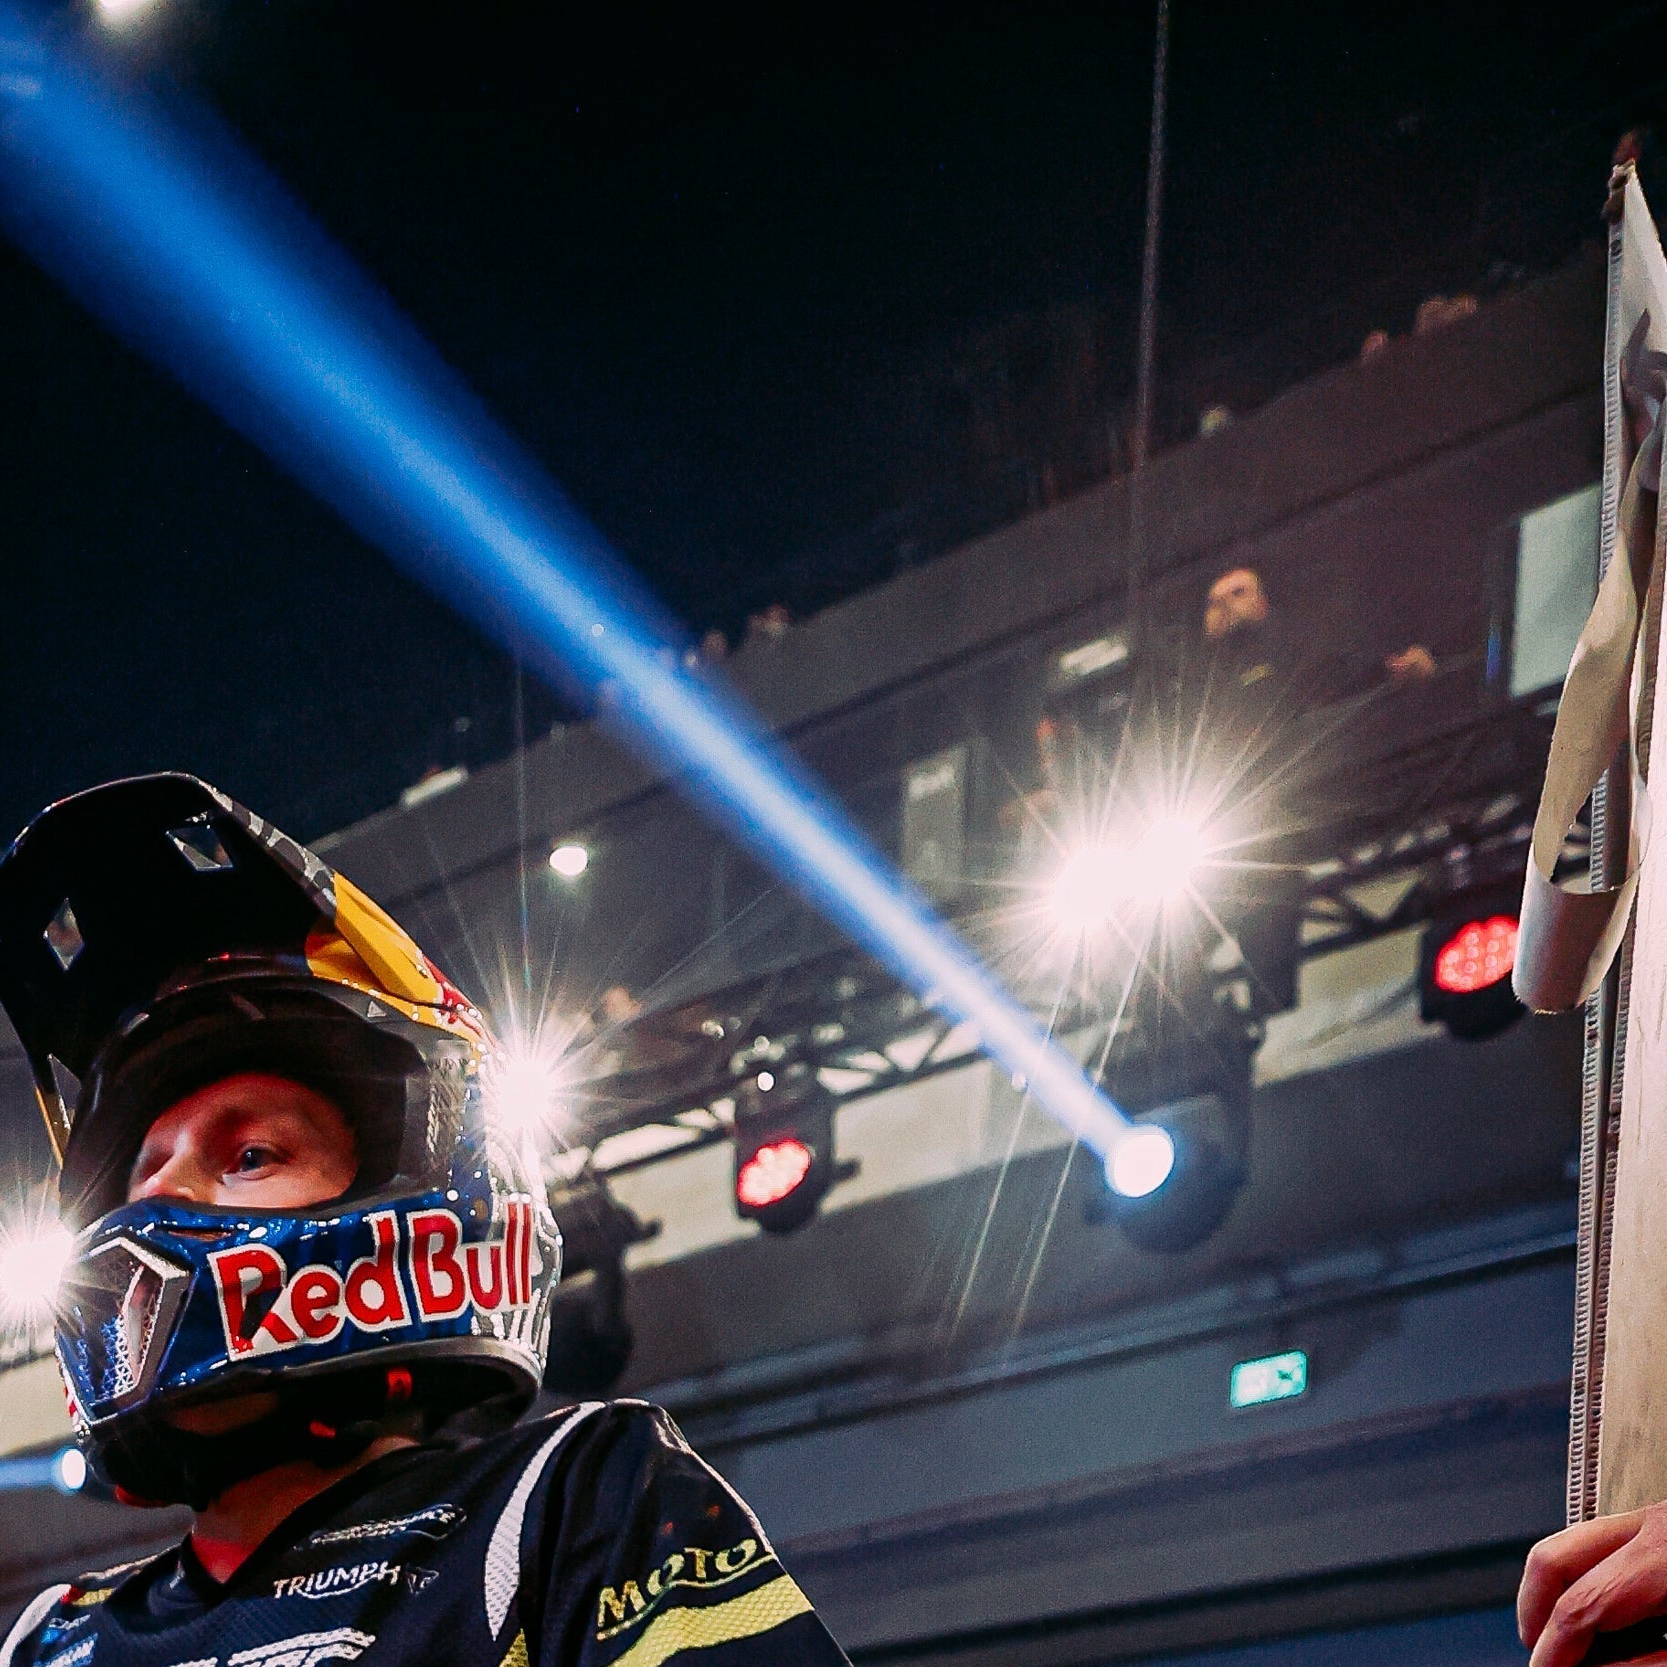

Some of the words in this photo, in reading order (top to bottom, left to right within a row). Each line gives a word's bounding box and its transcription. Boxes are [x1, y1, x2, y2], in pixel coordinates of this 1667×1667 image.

[210, 1212, 412, 1358] Red
[409, 1194, 534, 1321] Bull
[272, 1560, 402, 1600] TRIUMPH
[596, 1537, 761, 1628] MOTO
